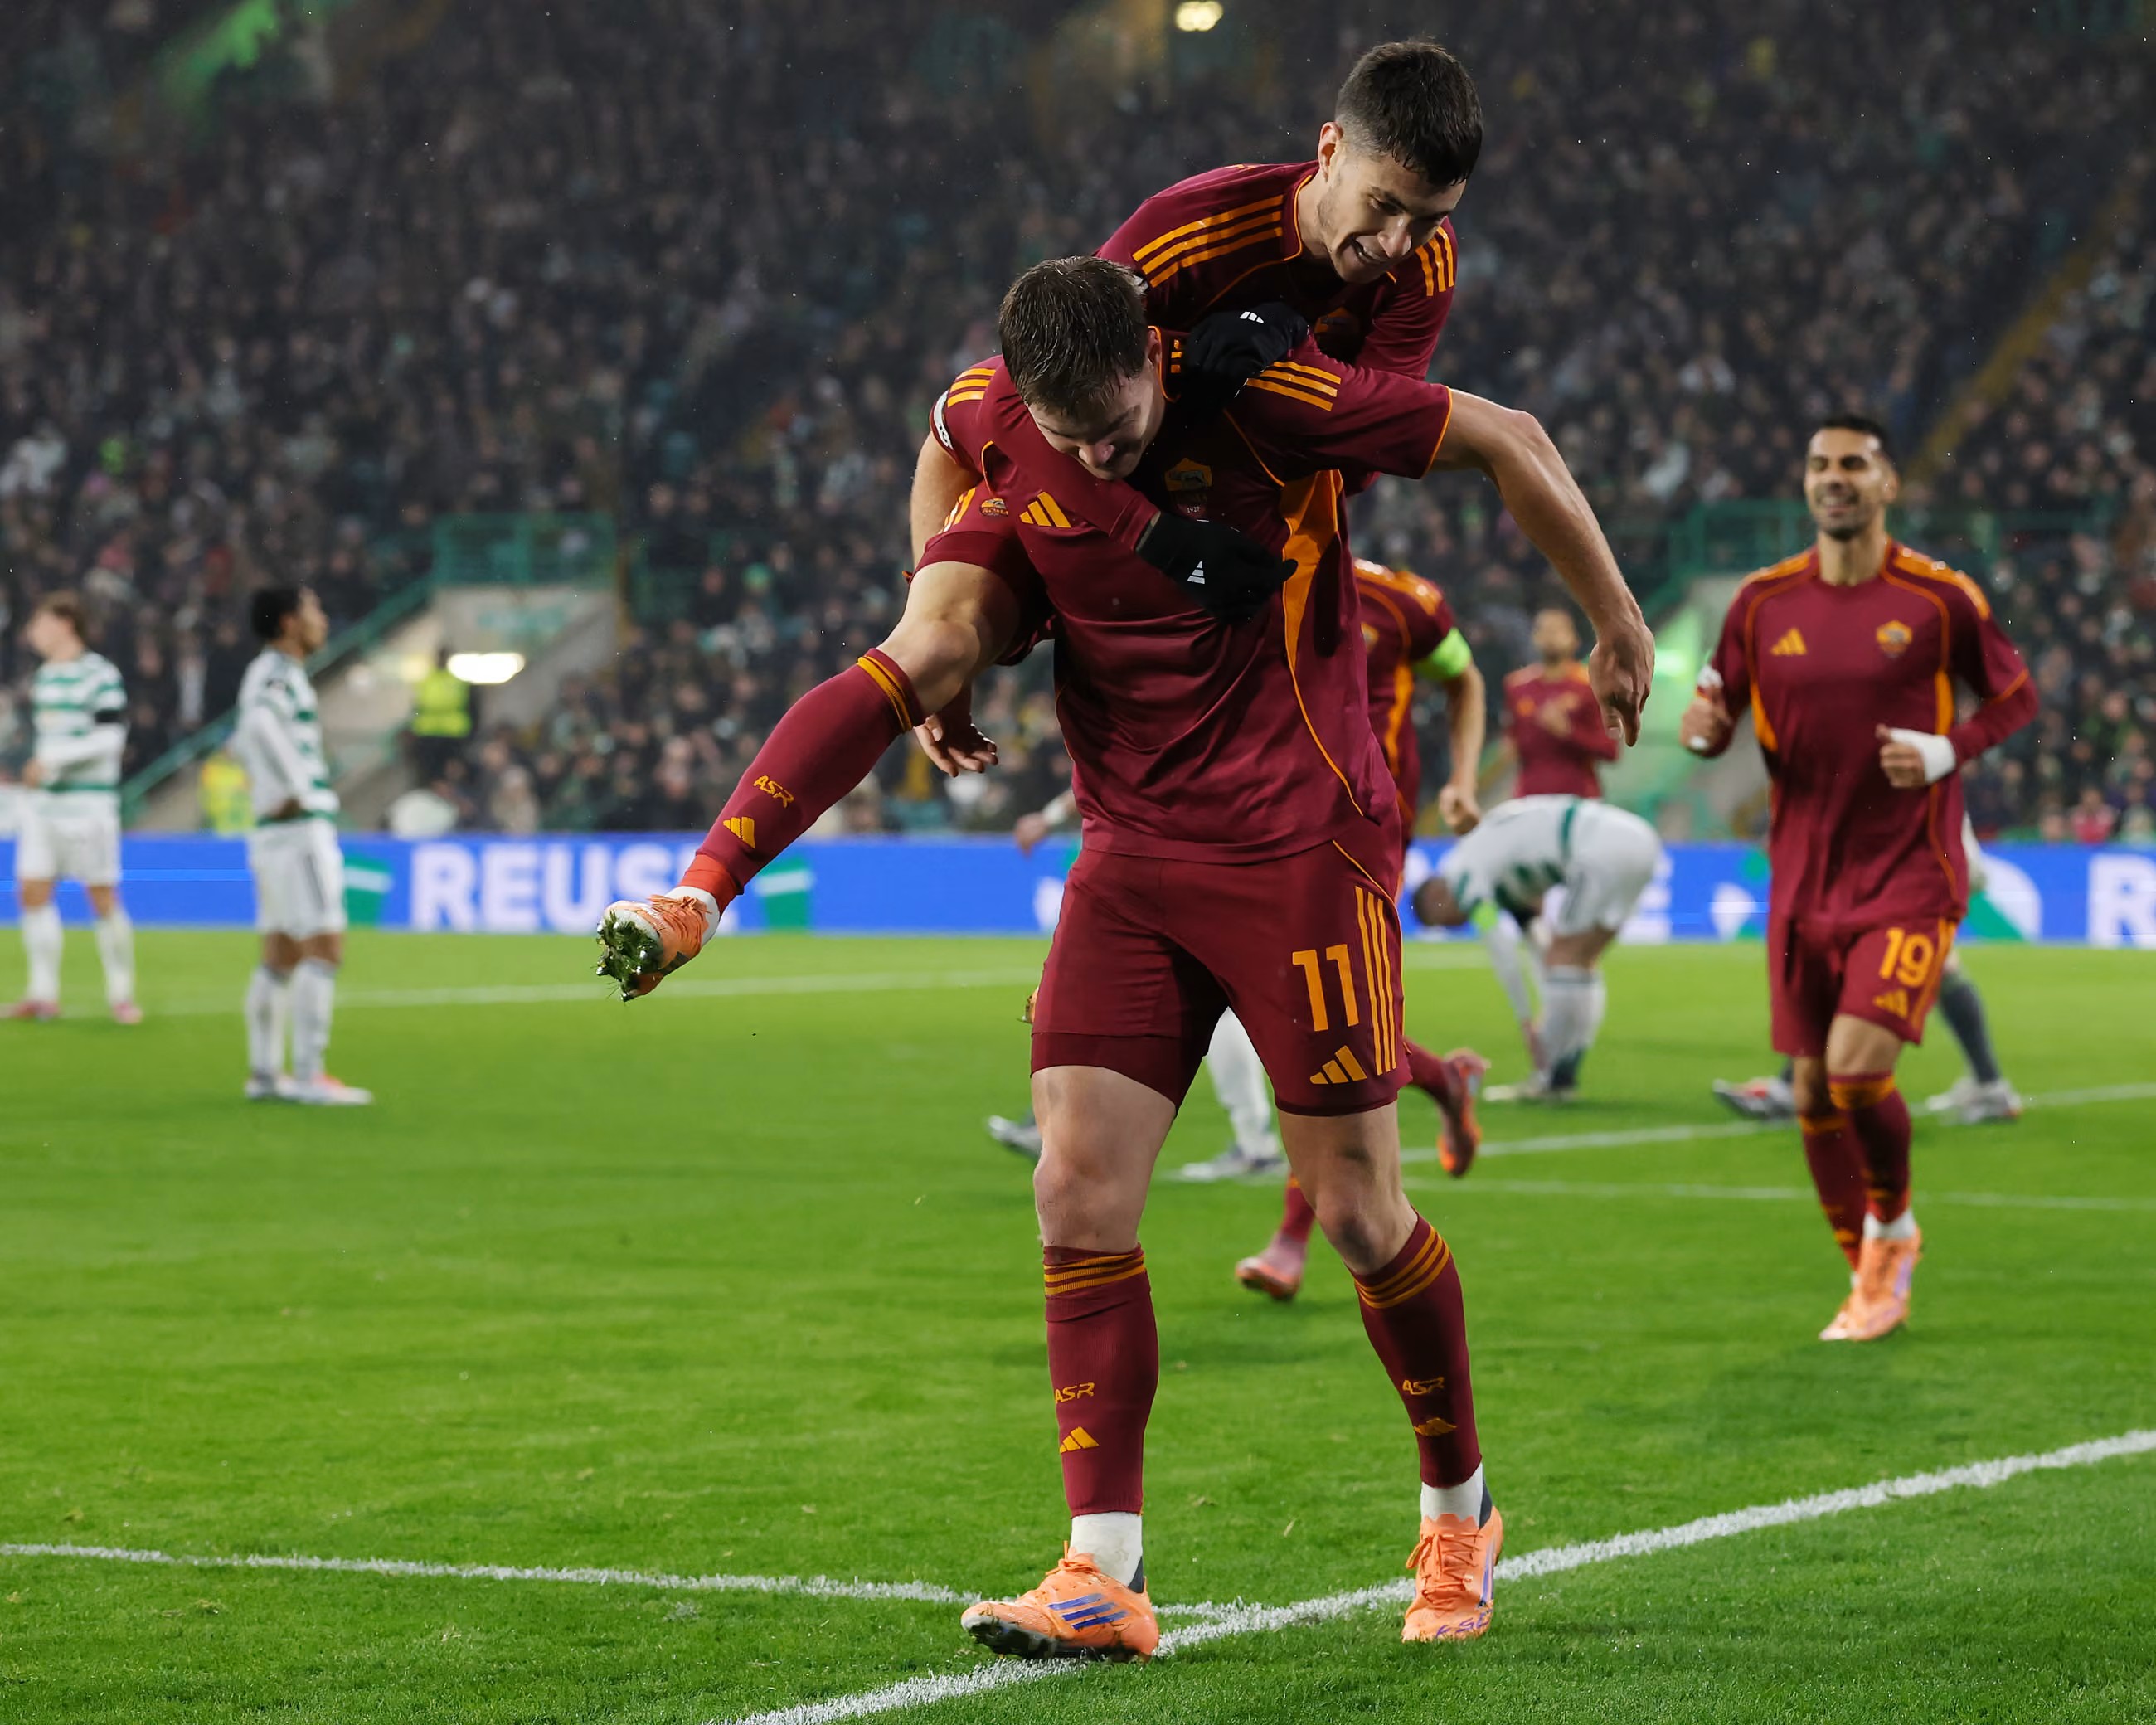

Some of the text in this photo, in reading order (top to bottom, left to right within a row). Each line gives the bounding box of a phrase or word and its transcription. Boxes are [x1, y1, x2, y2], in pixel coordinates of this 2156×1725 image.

[754, 775, 794, 808] ASR
[1879, 927, 1935, 987] 19
[1293, 944, 1360, 1032] 11
[1056, 1382, 1095, 1404] ASR
